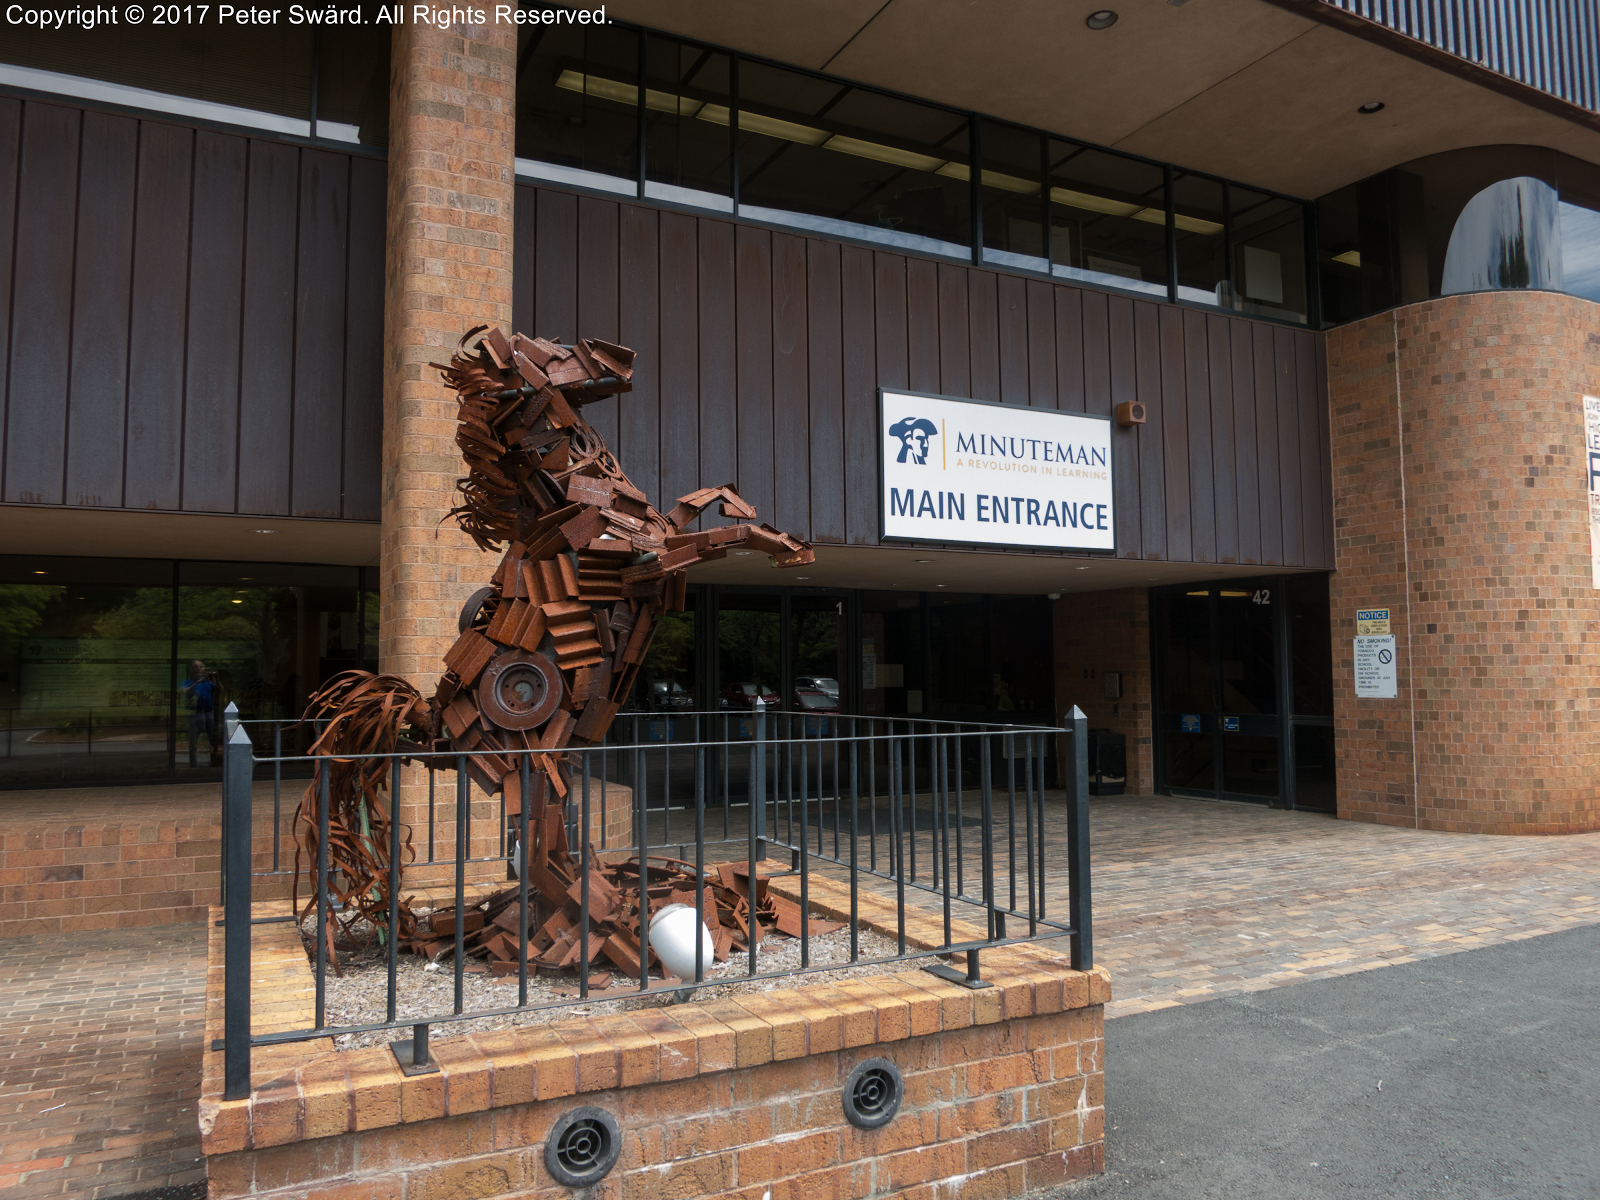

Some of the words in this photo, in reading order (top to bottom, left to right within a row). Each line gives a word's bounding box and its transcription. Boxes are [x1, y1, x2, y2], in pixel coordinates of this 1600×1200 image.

[955, 431, 1107, 467] MINUTEMAN
[956, 458, 964, 467] A
[968, 459, 1038, 474] REVOLUTION
[1041, 466, 1052, 475] IN
[1056, 467, 1108, 480] LEARNING
[890, 487, 965, 521] MAIN
[976, 494, 1108, 530] ENTRANCE
[1252, 589, 1271, 605] 42
[835, 601, 843, 616] 1
[1359, 611, 1387, 620] NOTICE
